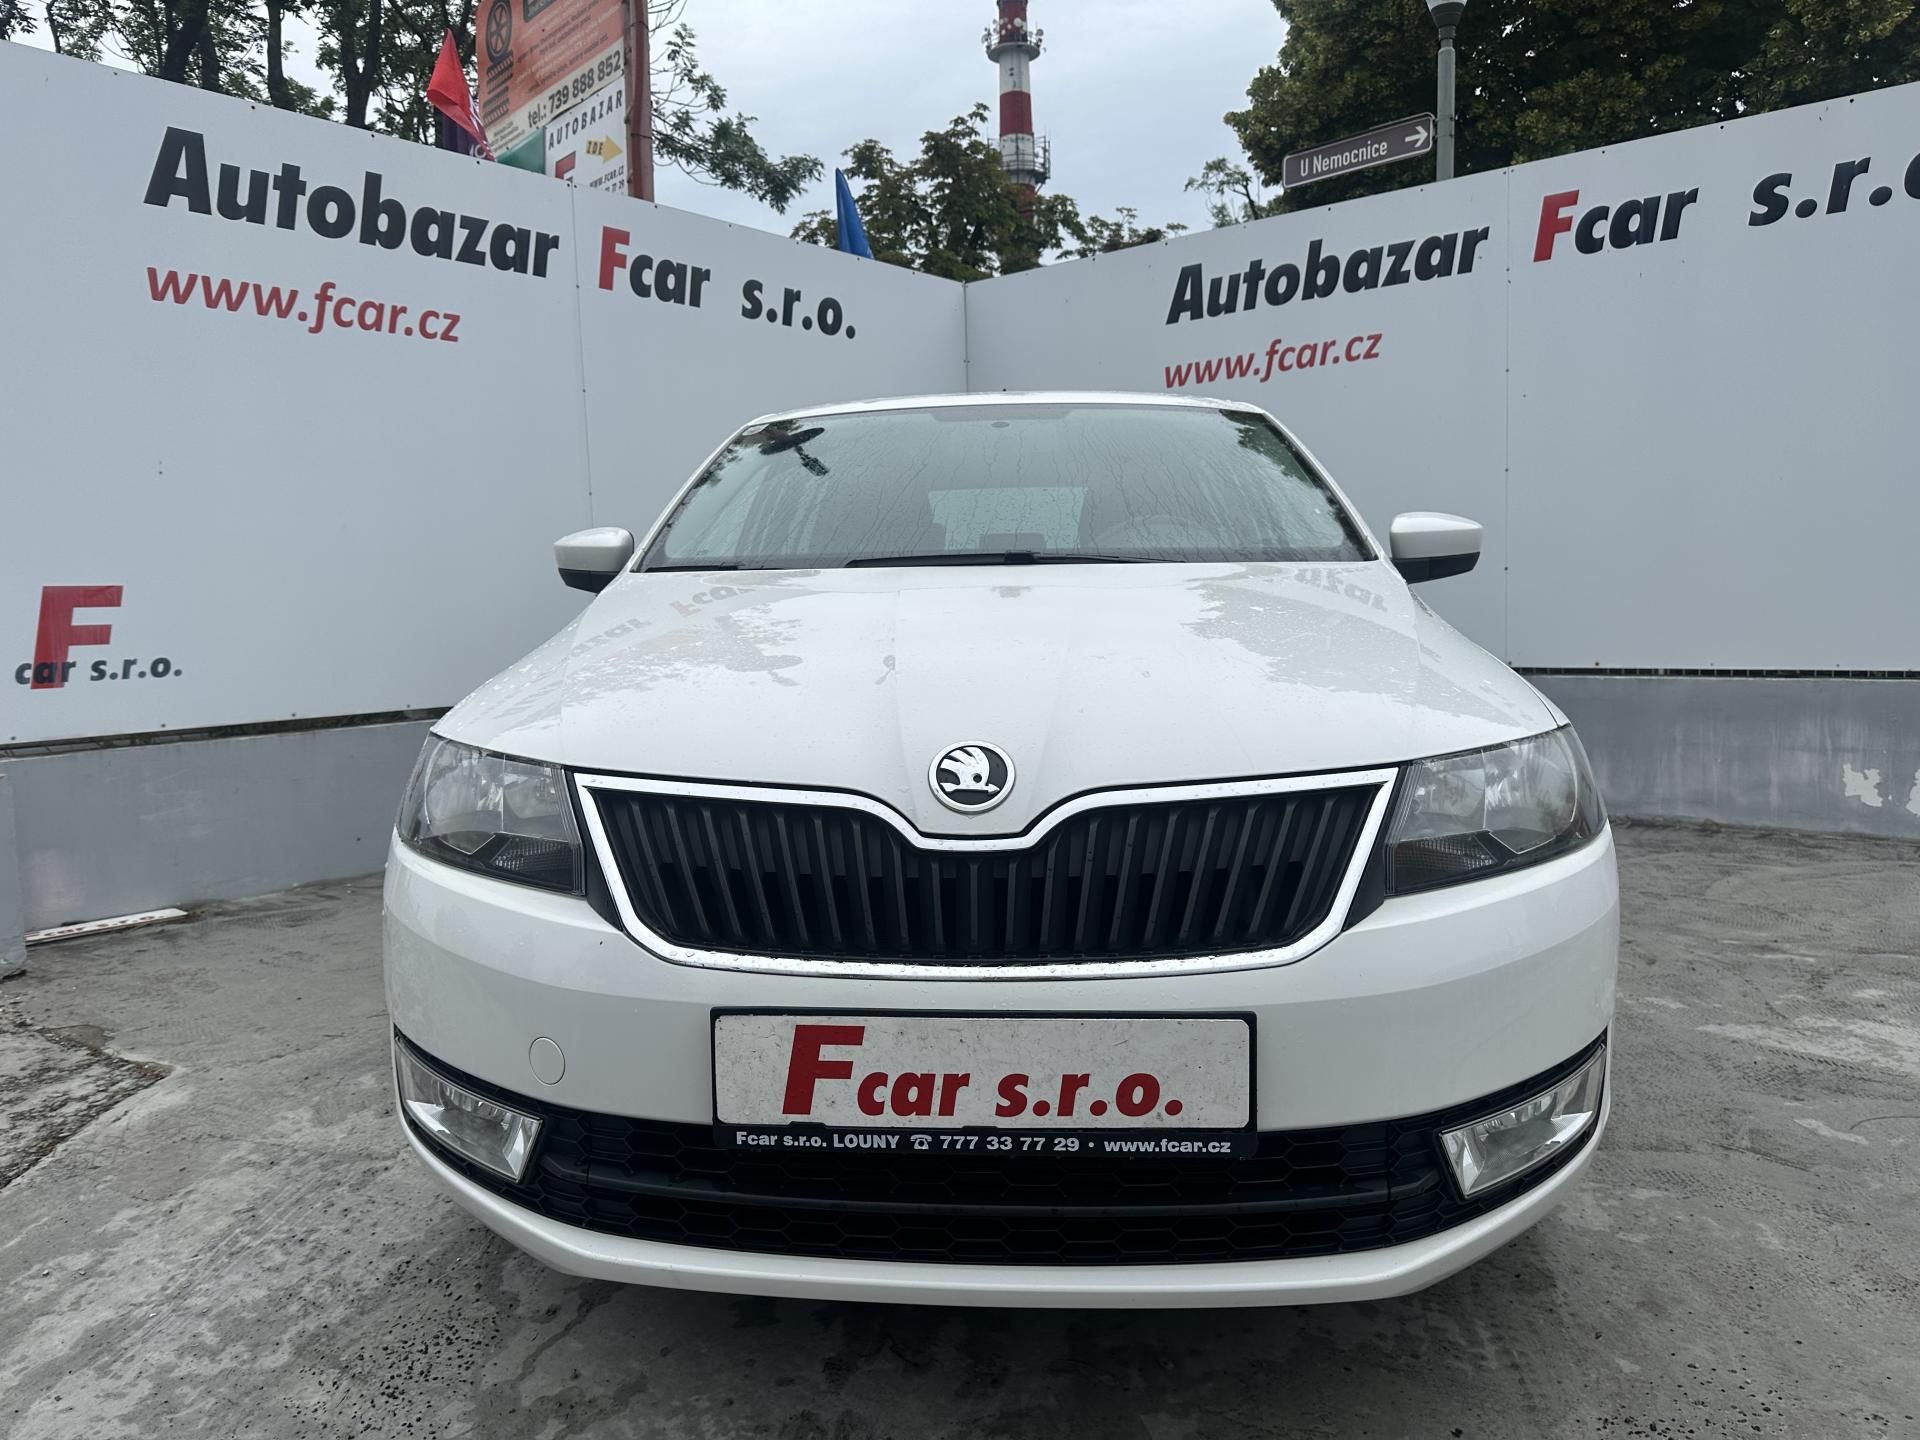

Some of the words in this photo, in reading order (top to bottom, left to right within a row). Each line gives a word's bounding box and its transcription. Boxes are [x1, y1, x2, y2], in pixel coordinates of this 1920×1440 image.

[528, 103, 547, 128] tel.:
[548, 85, 569, 114] 739
[572, 71, 595, 102] 888
[597, 50, 621, 81] 852
[548, 89, 623, 150] AUTOBAZAR
[1300, 159, 1309, 177] U
[1313, 140, 1388, 174] Nemocnice
[144, 126, 561, 278] Autobazar
[598, 226, 711, 308] Fcar
[742, 279, 856, 340] s.r.o.
[1165, 226, 1490, 325] Autobazar
[1534, 189, 1700, 263] Fcar
[147, 266, 460, 342] www.fcar.cz
[1164, 333, 1382, 389] www.fcar.cz
[90, 657, 183, 682] s.r.o.
[782, 1024, 971, 1117] Fcar
[994, 1072, 1184, 1118] s.r.o.
[736, 1131, 778, 1146] Fcar
[783, 1134, 827, 1148] s.r.o.
[833, 1134, 900, 1149] LOUNY
[939, 1135, 979, 1150] 777
[986, 1136, 1013, 1150] 33
[1020, 1137, 1046, 1151] 77
[1053, 1137, 1080, 1152] 29
[1103, 1138, 1232, 1154] www.fcar.cz
